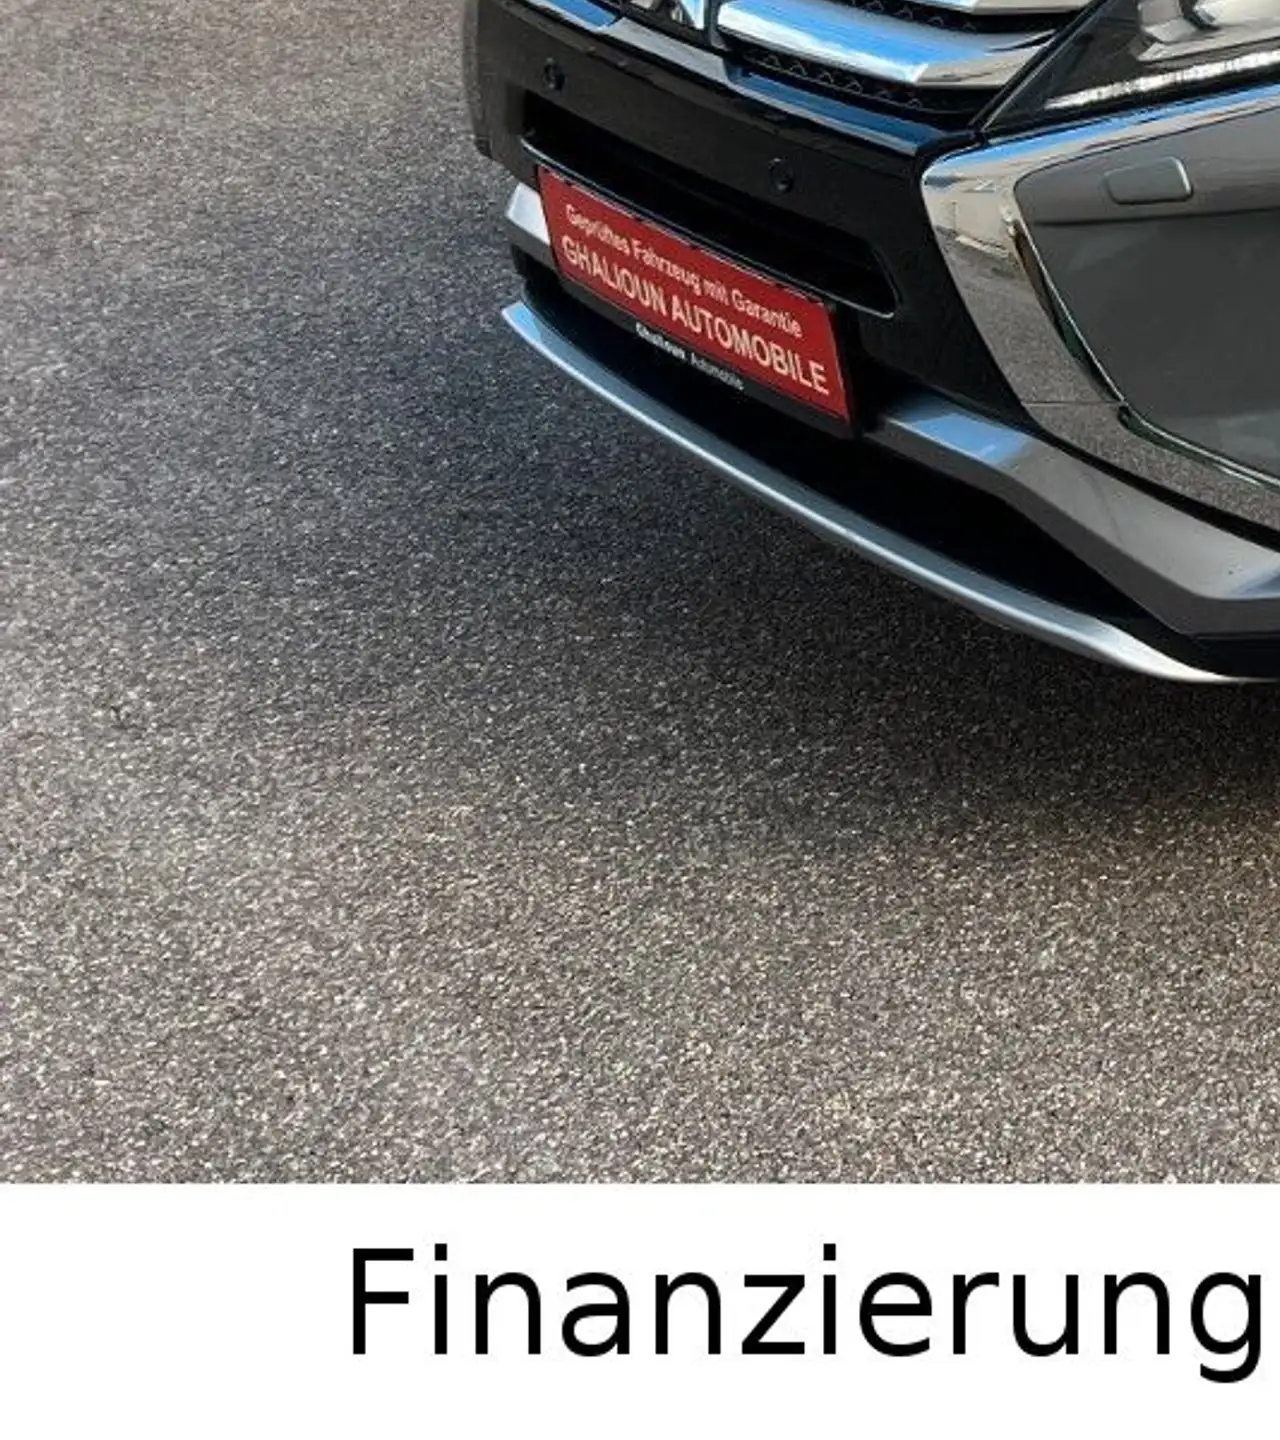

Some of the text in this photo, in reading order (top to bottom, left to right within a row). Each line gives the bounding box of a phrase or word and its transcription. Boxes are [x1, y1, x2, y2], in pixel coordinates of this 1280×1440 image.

[631, 238, 702, 297] Fahrzeug
[731, 288, 803, 339] Garantie
[671, 294, 830, 395] AUTOMOBILE
